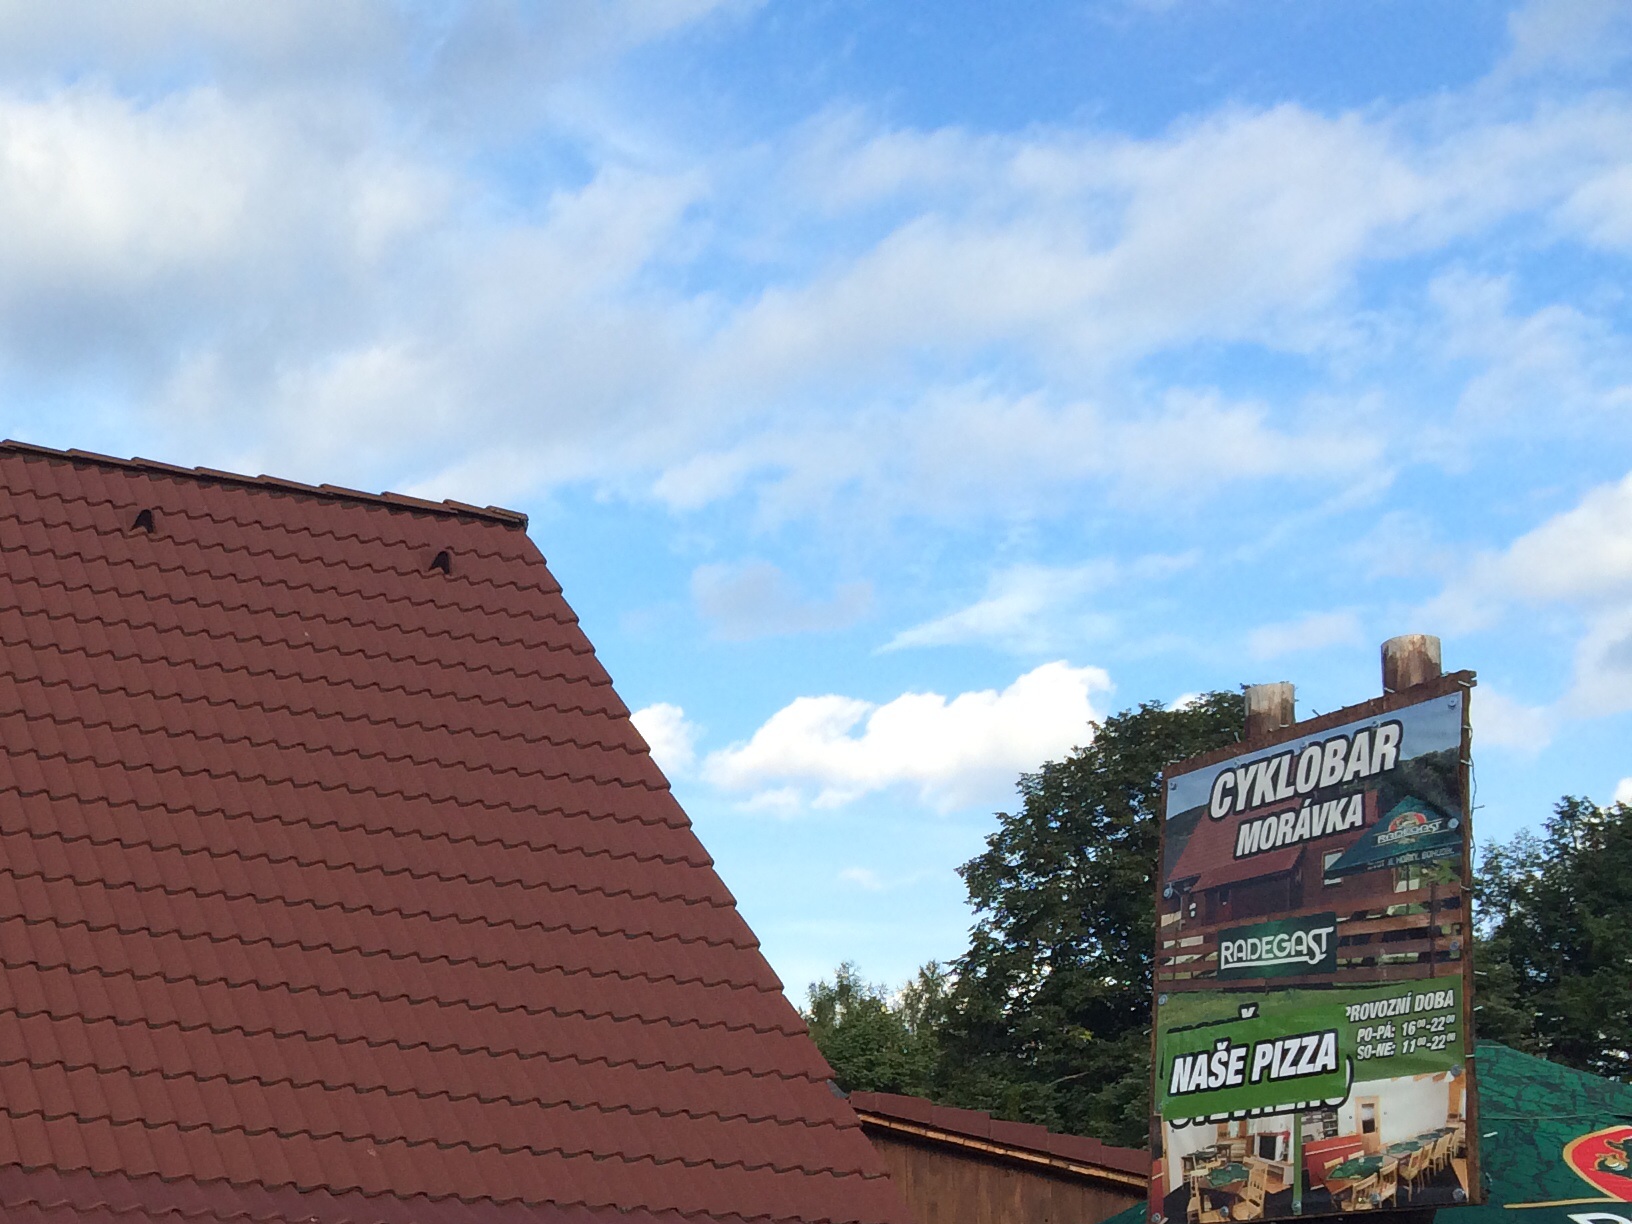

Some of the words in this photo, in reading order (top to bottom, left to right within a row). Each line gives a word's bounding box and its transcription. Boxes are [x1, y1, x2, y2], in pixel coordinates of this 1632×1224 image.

[1210, 723, 1401, 820] CYKLOBAR
[1235, 793, 1363, 857] MORÁVKA
[1221, 926, 1334, 970] RADEGAST
[1414, 990, 1454, 1012] DOBA
[1357, 1021, 1396, 1043] PO-PÁ:
[1357, 1042, 1396, 1060] SO-NE:
[1169, 1040, 1248, 1095] NAŠE
[1250, 1032, 1339, 1083] PIZZA
